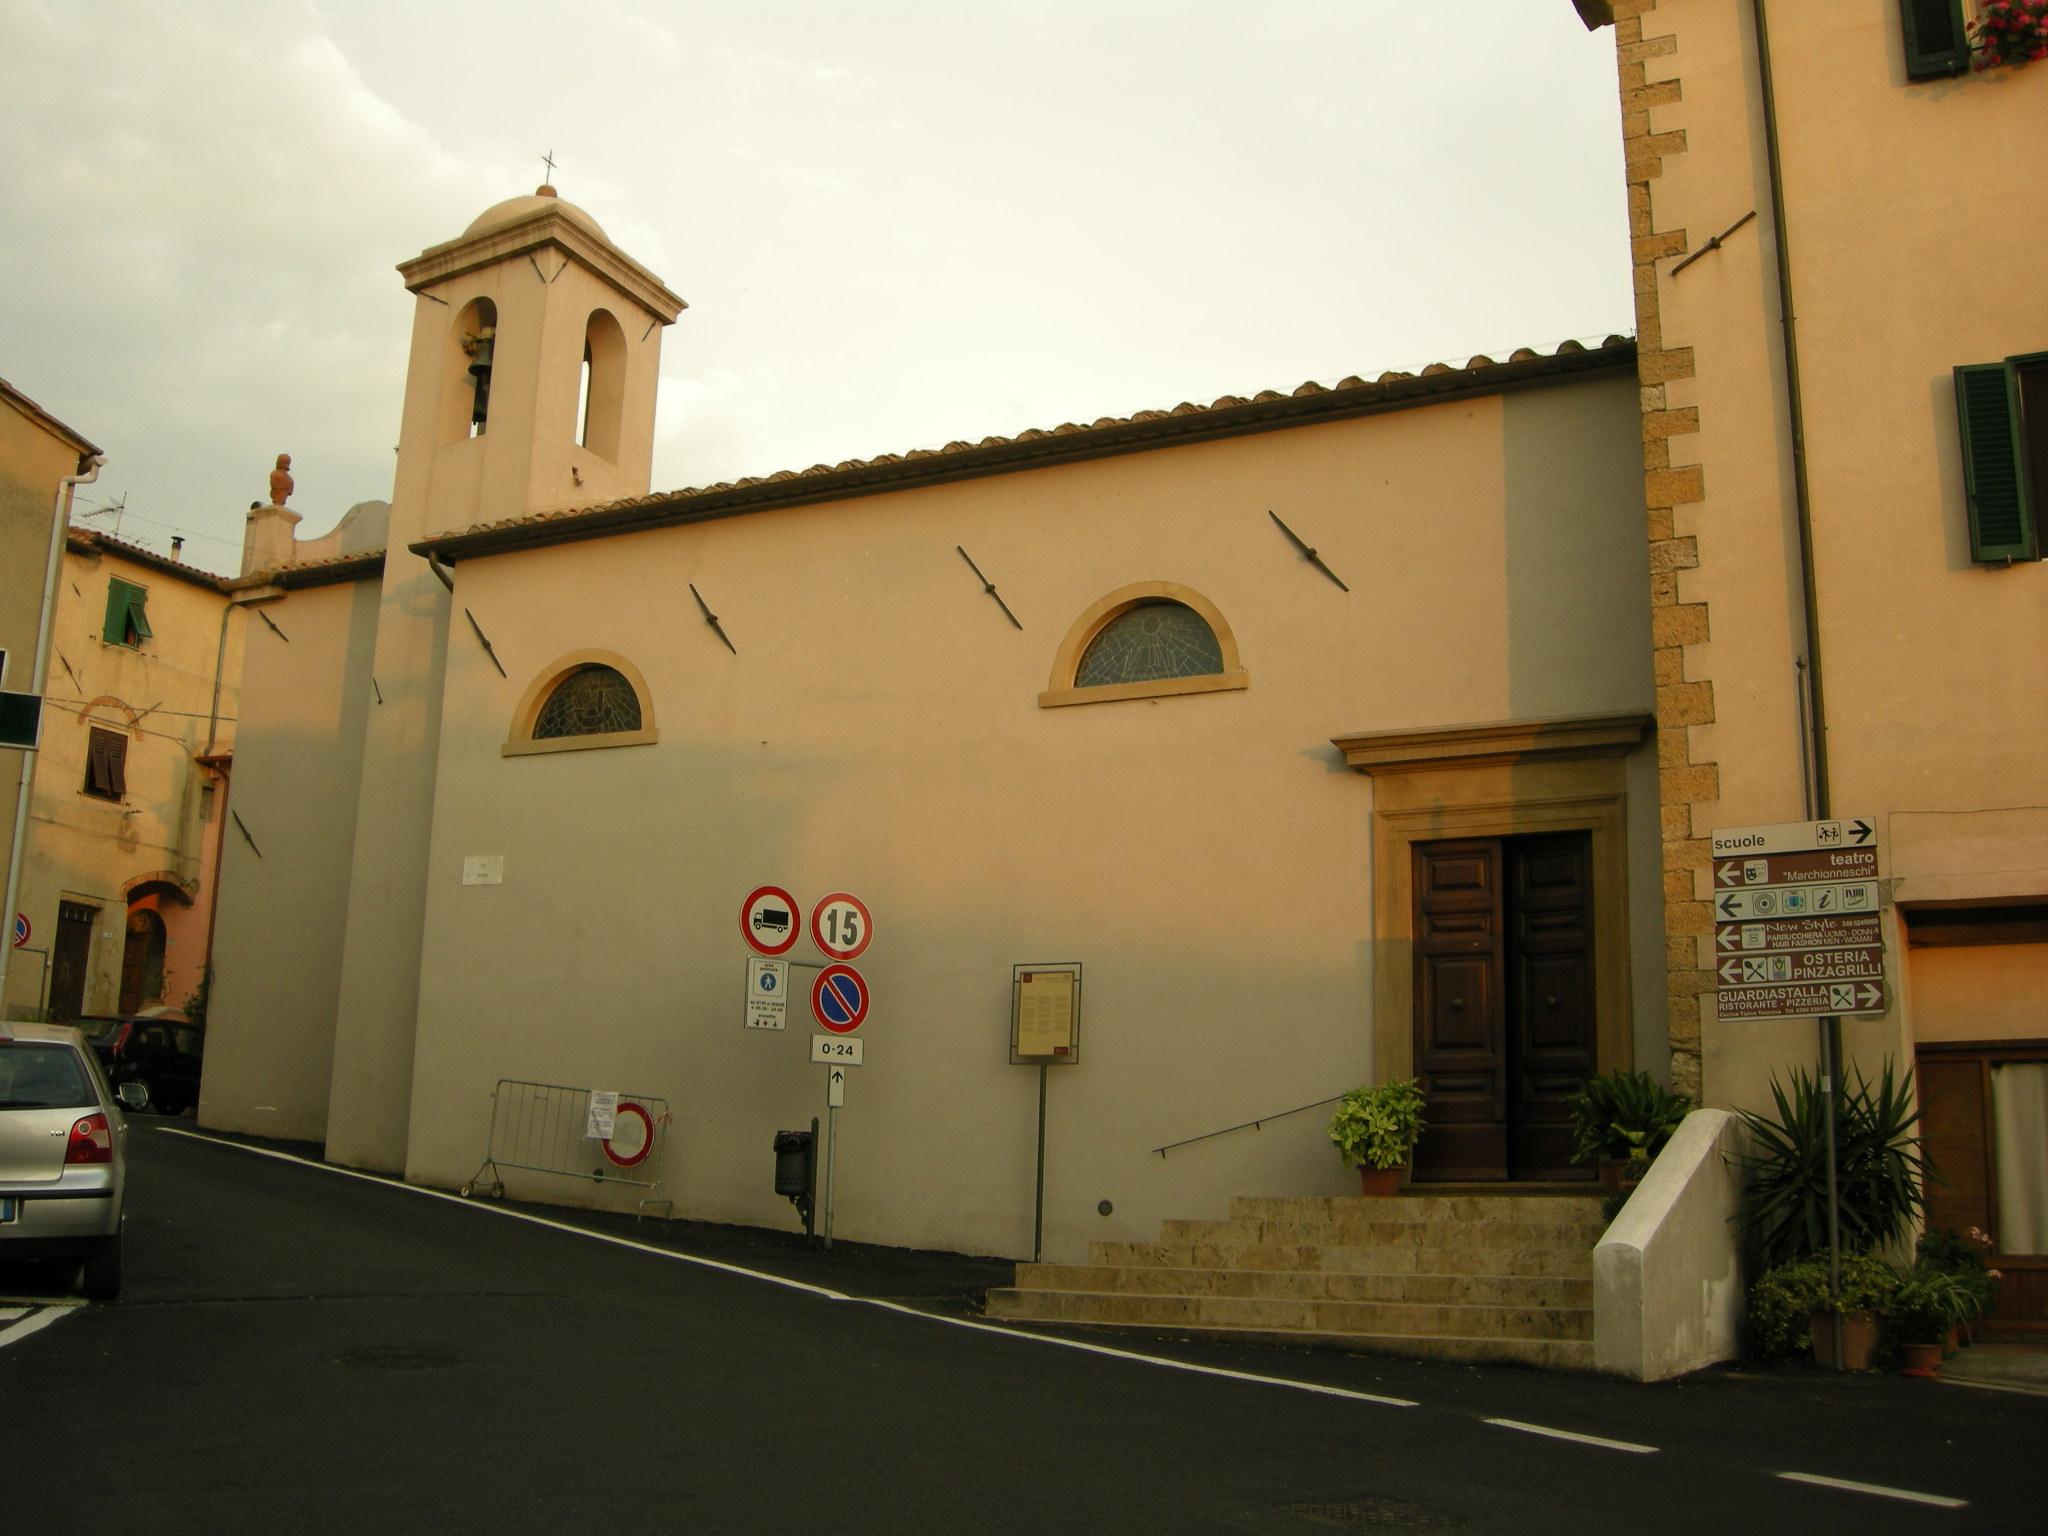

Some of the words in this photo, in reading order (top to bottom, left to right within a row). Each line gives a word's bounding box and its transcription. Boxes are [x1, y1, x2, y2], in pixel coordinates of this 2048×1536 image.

[1715, 834, 1765, 849] scuole
[1830, 852, 1874, 866] teatro
[828, 909, 858, 946] 15
[1766, 922, 1798, 932] New
[1802, 918, 1838, 931] Style
[1767, 931, 1823, 942] PARRUCCHIERA
[1772, 940, 1790, 949] HAIR
[1791, 937, 1823, 947] FASHION
[1844, 935, 1873, 944] WOMAN
[1804, 951, 1870, 966] OSTERIA
[1794, 963, 1881, 979] PINZAGRILLI
[1718, 986, 1829, 1002] GUARDIASTALLA
[1718, 1000, 1777, 1011] RISTORANTE
[1786, 997, 1829, 1006] PIZZERIA
[822, 1043, 854, 1056] 0-24
